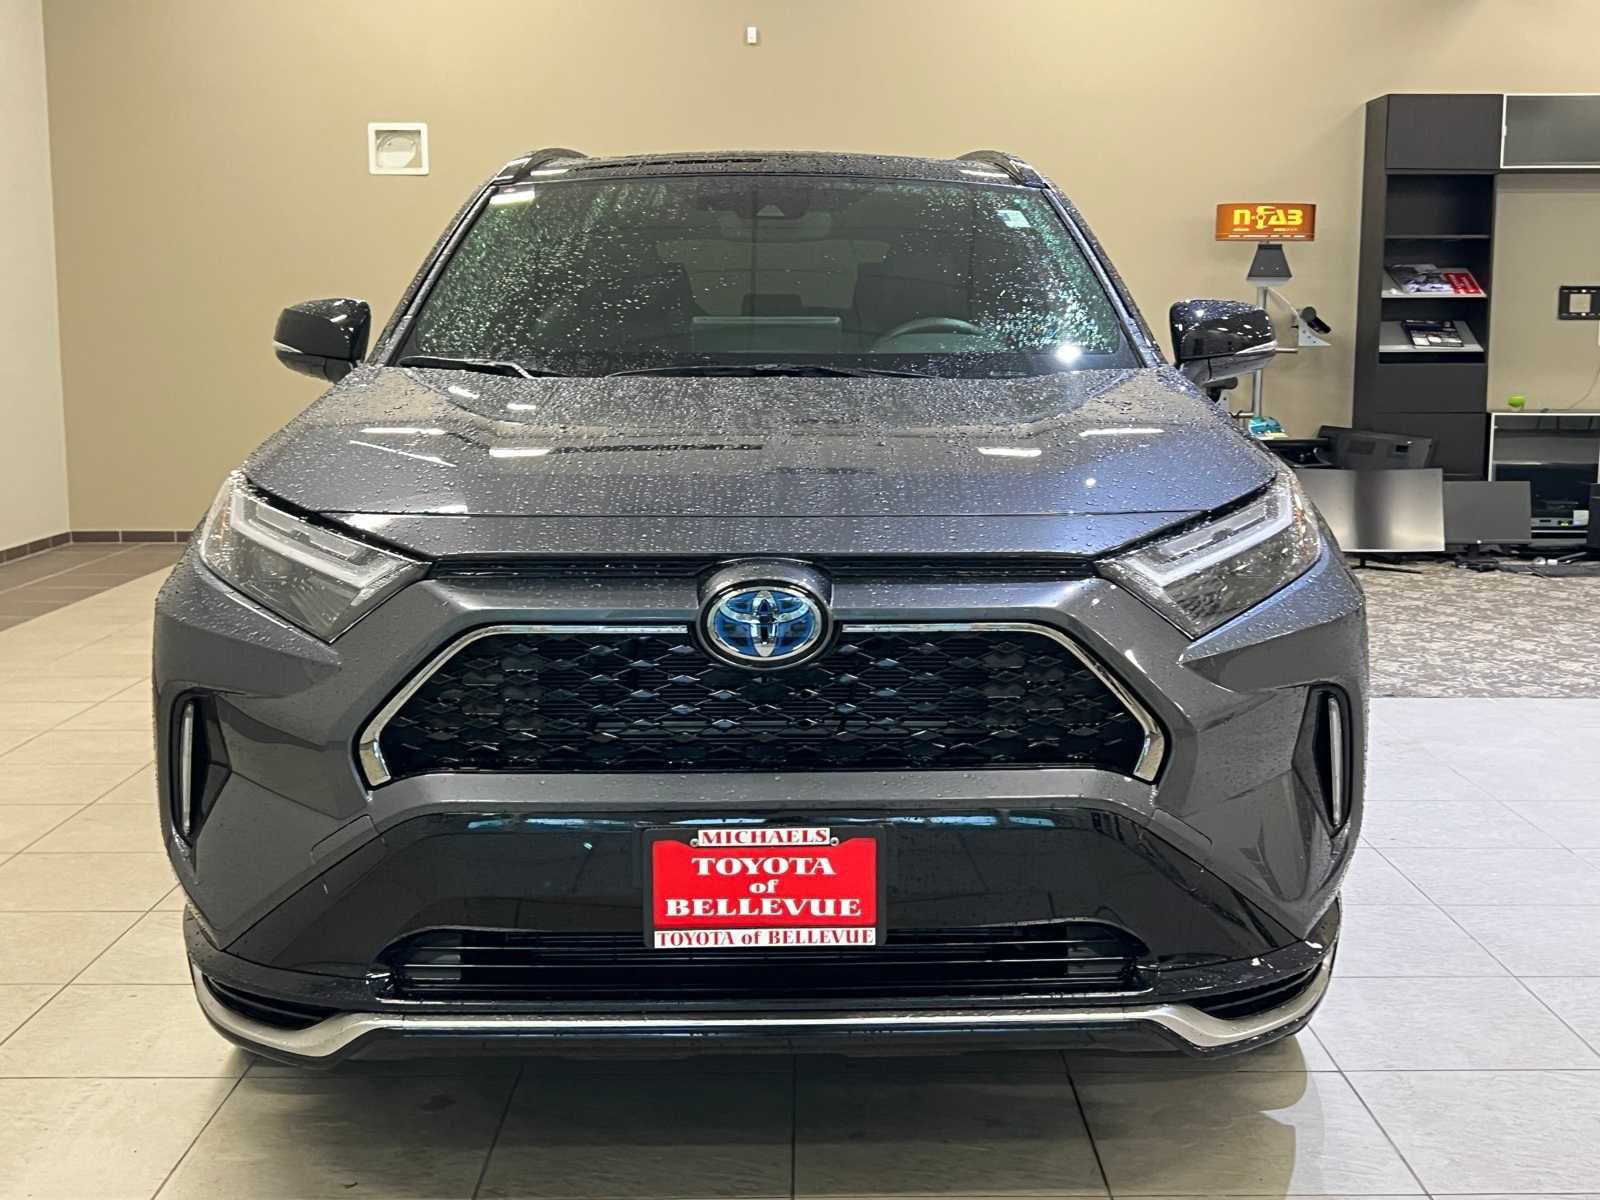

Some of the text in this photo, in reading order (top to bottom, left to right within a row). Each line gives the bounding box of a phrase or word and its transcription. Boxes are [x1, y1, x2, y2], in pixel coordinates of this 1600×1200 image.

[701, 829, 828, 845] MICHAELS
[691, 857, 836, 876] TOYOTA
[749, 879, 779, 894] of
[665, 898, 861, 917] BELLEVUE
[657, 929, 873, 947] TOYOTA of BELLEVUE
